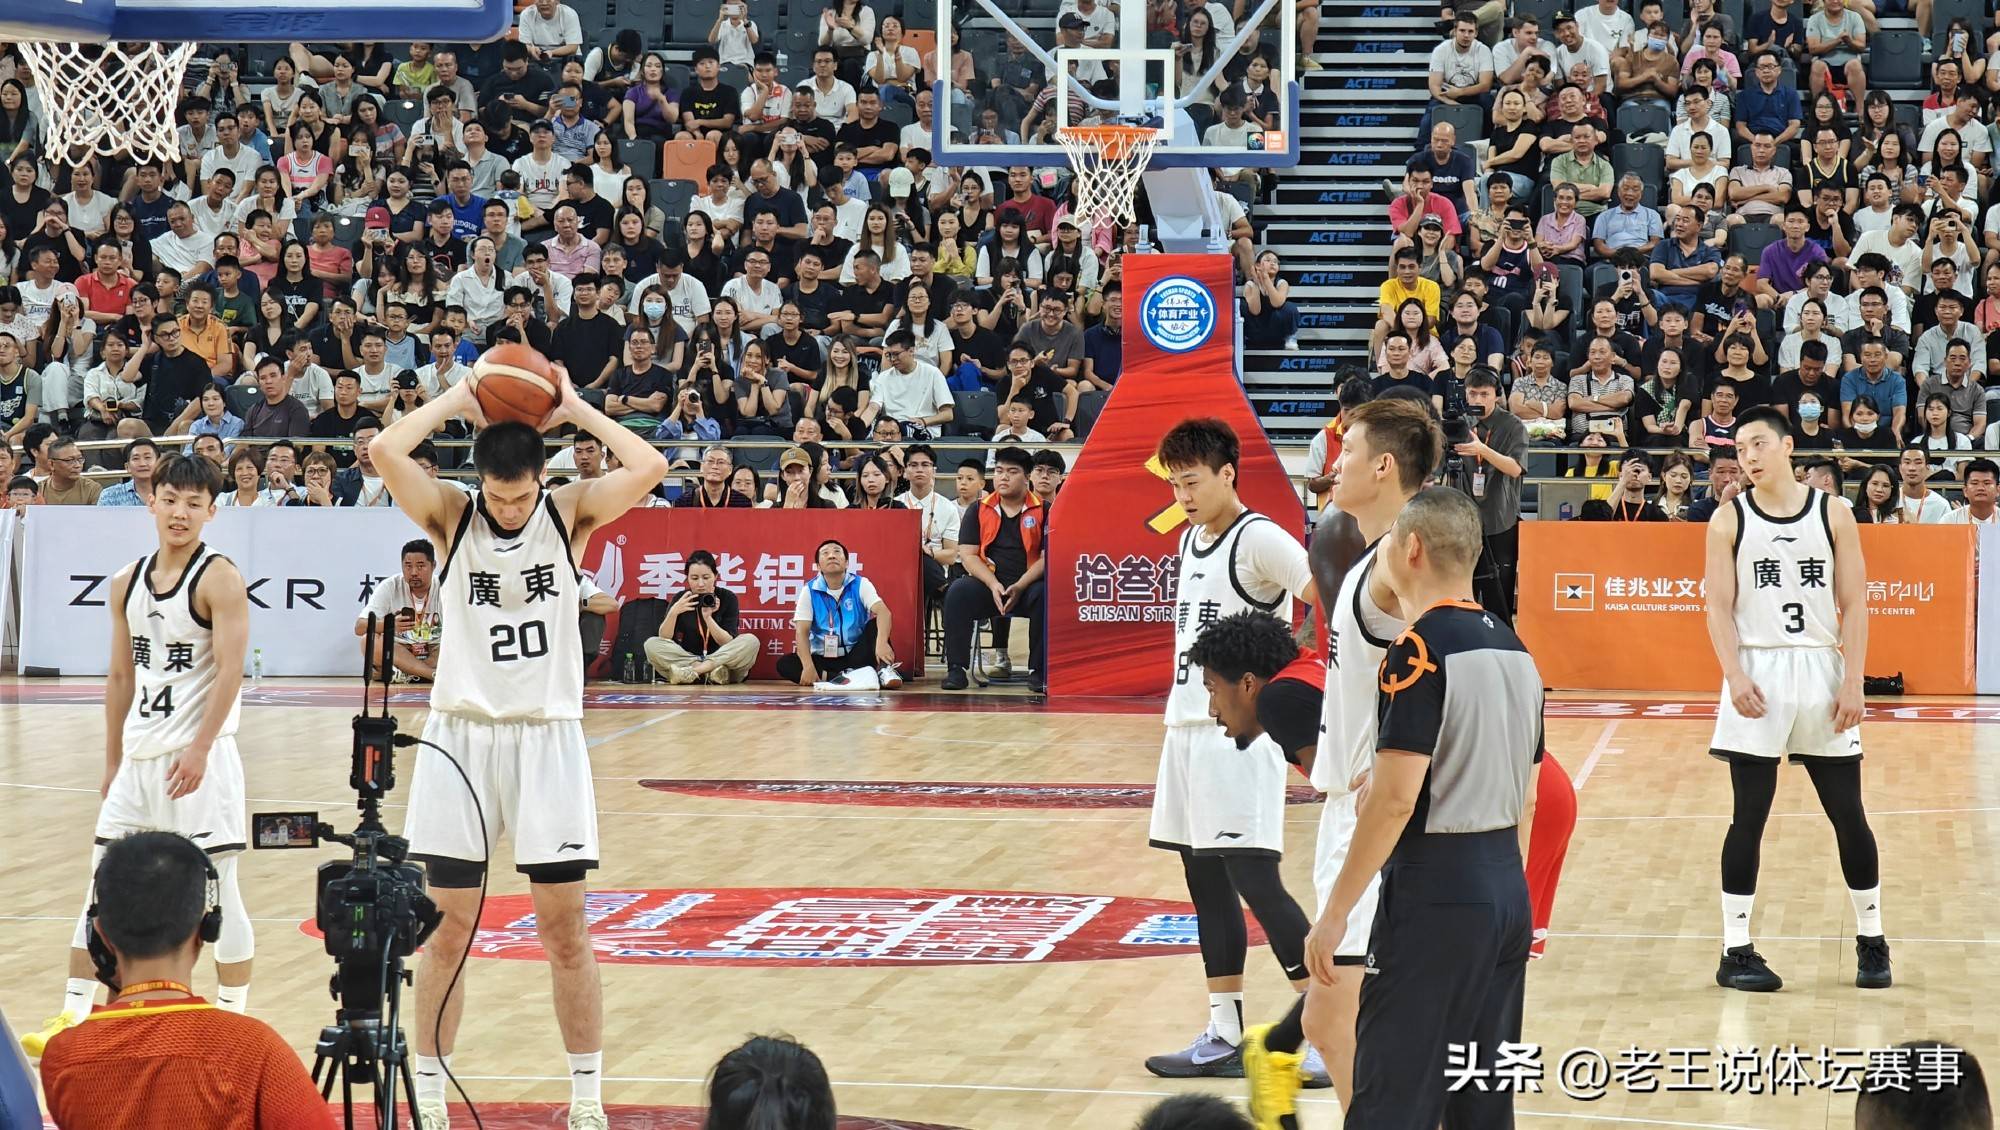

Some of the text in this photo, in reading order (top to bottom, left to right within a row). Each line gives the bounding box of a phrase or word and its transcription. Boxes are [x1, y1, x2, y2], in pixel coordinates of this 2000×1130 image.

[1362, 7, 1387, 17] ACT
[1354, 42, 1380, 52] ACT
[1345, 78, 1371, 89] ACT
[1336, 115, 1363, 126] ACT
[1328, 153, 1356, 164] ACT
[1318, 191, 1346, 202] ACT
[1309, 231, 1337, 242] ACT
[1299, 272, 1328, 284] ACT
[1158, 308, 1199, 320] 体育产业
[1298, 314, 1319, 326] CT
[1280, 358, 1308, 369] ACT
[1268, 401, 1298, 413] ACT
[637, 552, 864, 605] 季华铝
[1753, 557, 1827, 589] 廣東
[468, 563, 560, 608] 廣東
[68, 575, 326, 610] ZKR
[1079, 605, 1140, 622] SHISAN
[1604, 603, 1629, 612] KAISA
[1631, 603, 1667, 612] CULTURE
[1669, 603, 1701, 612] SPORTS
[1882, 607, 1916, 616] CENTER
[1782, 602, 1805, 634] 3
[490, 620, 549, 662] 20
